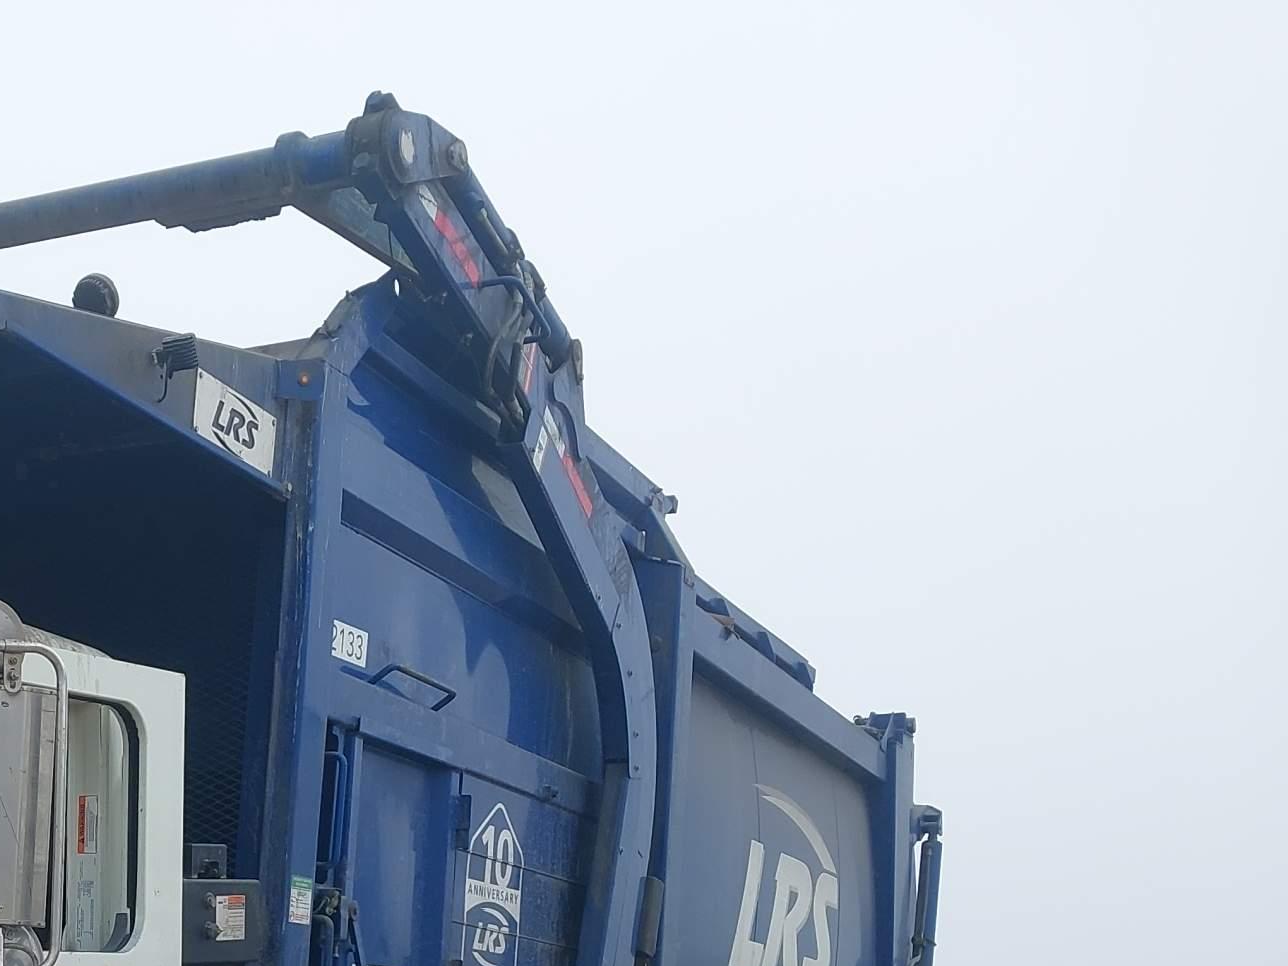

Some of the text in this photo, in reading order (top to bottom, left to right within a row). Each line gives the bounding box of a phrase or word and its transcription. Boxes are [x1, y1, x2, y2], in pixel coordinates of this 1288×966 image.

[212, 400, 259, 450] LRS
[481, 825, 514, 888] 10
[467, 883, 519, 906] ANNIVERSARY
[472, 921, 509, 954] LRS
